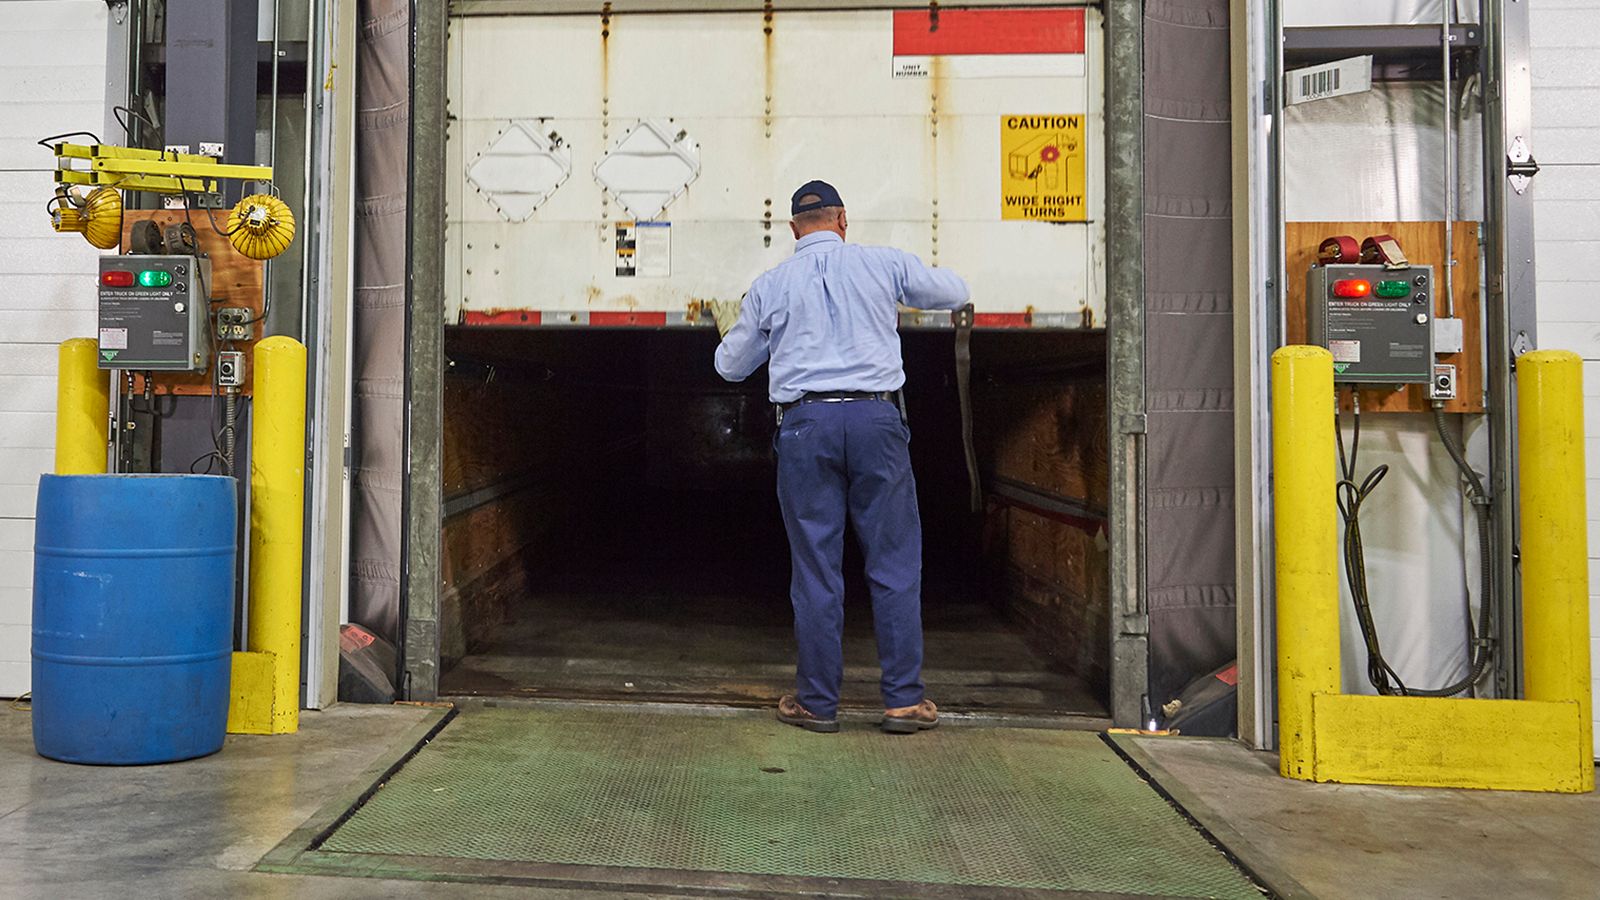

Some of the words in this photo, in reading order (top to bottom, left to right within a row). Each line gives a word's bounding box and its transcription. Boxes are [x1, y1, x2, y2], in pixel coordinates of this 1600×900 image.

[1007, 117, 1078, 129] CAUTION
[1005, 195, 1039, 206] WIDE
[1043, 195, 1082, 206] RIGHT
[1022, 207, 1065, 217] TURNS
